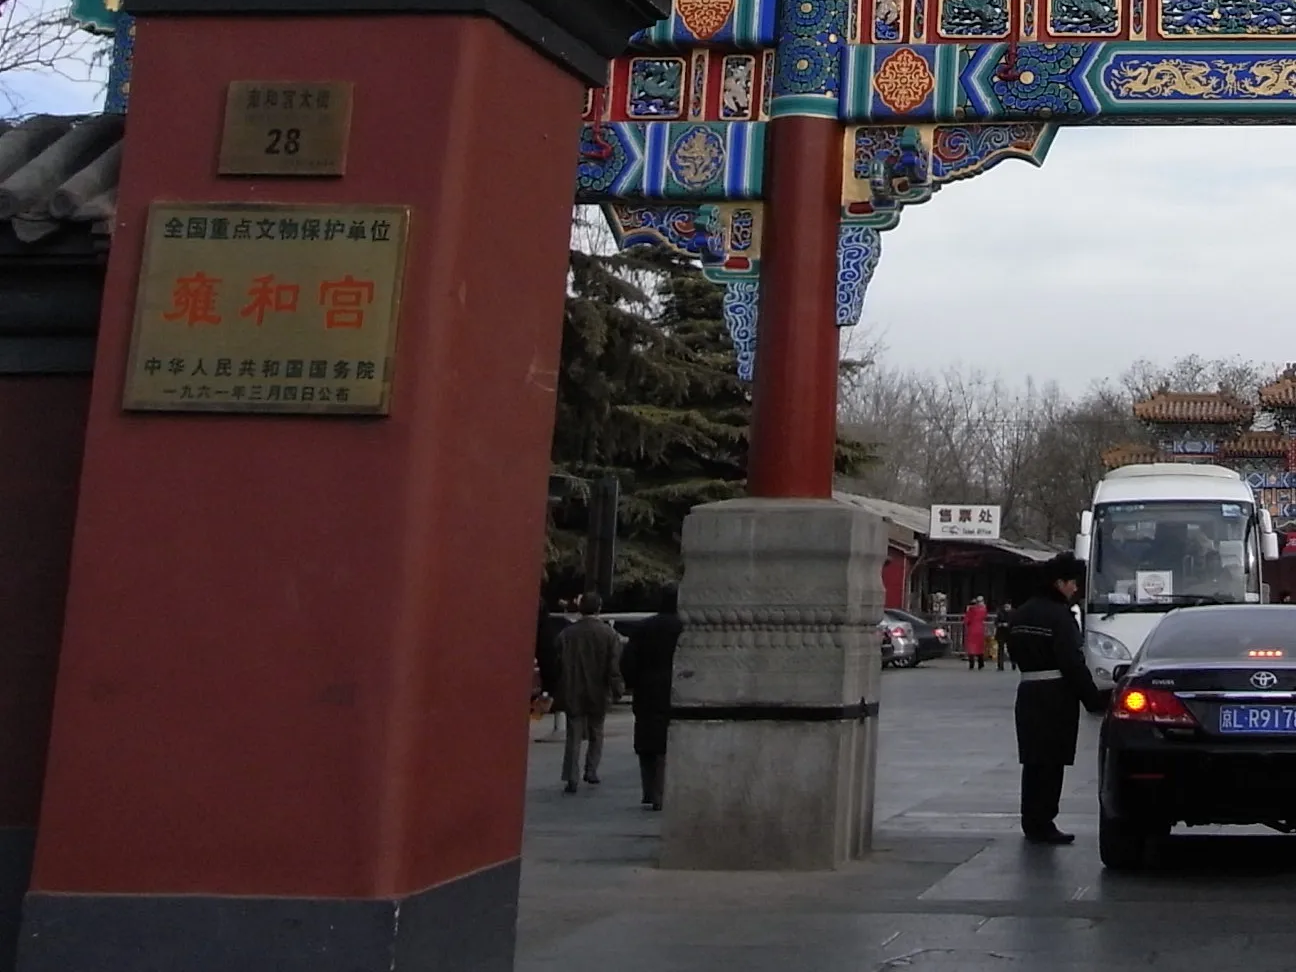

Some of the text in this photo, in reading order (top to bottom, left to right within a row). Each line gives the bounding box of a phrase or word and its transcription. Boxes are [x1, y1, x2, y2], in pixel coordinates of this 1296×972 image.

[264, 128, 301, 155] 28
[163, 216, 391, 242] 全国重点文物保护单位
[162, 272, 377, 330] 雍和宫
[144, 357, 376, 380] 中华人民共和国国务院
[163, 384, 351, 402] 一九六一年三月四日公布
[938, 508, 993, 523] 售票处
